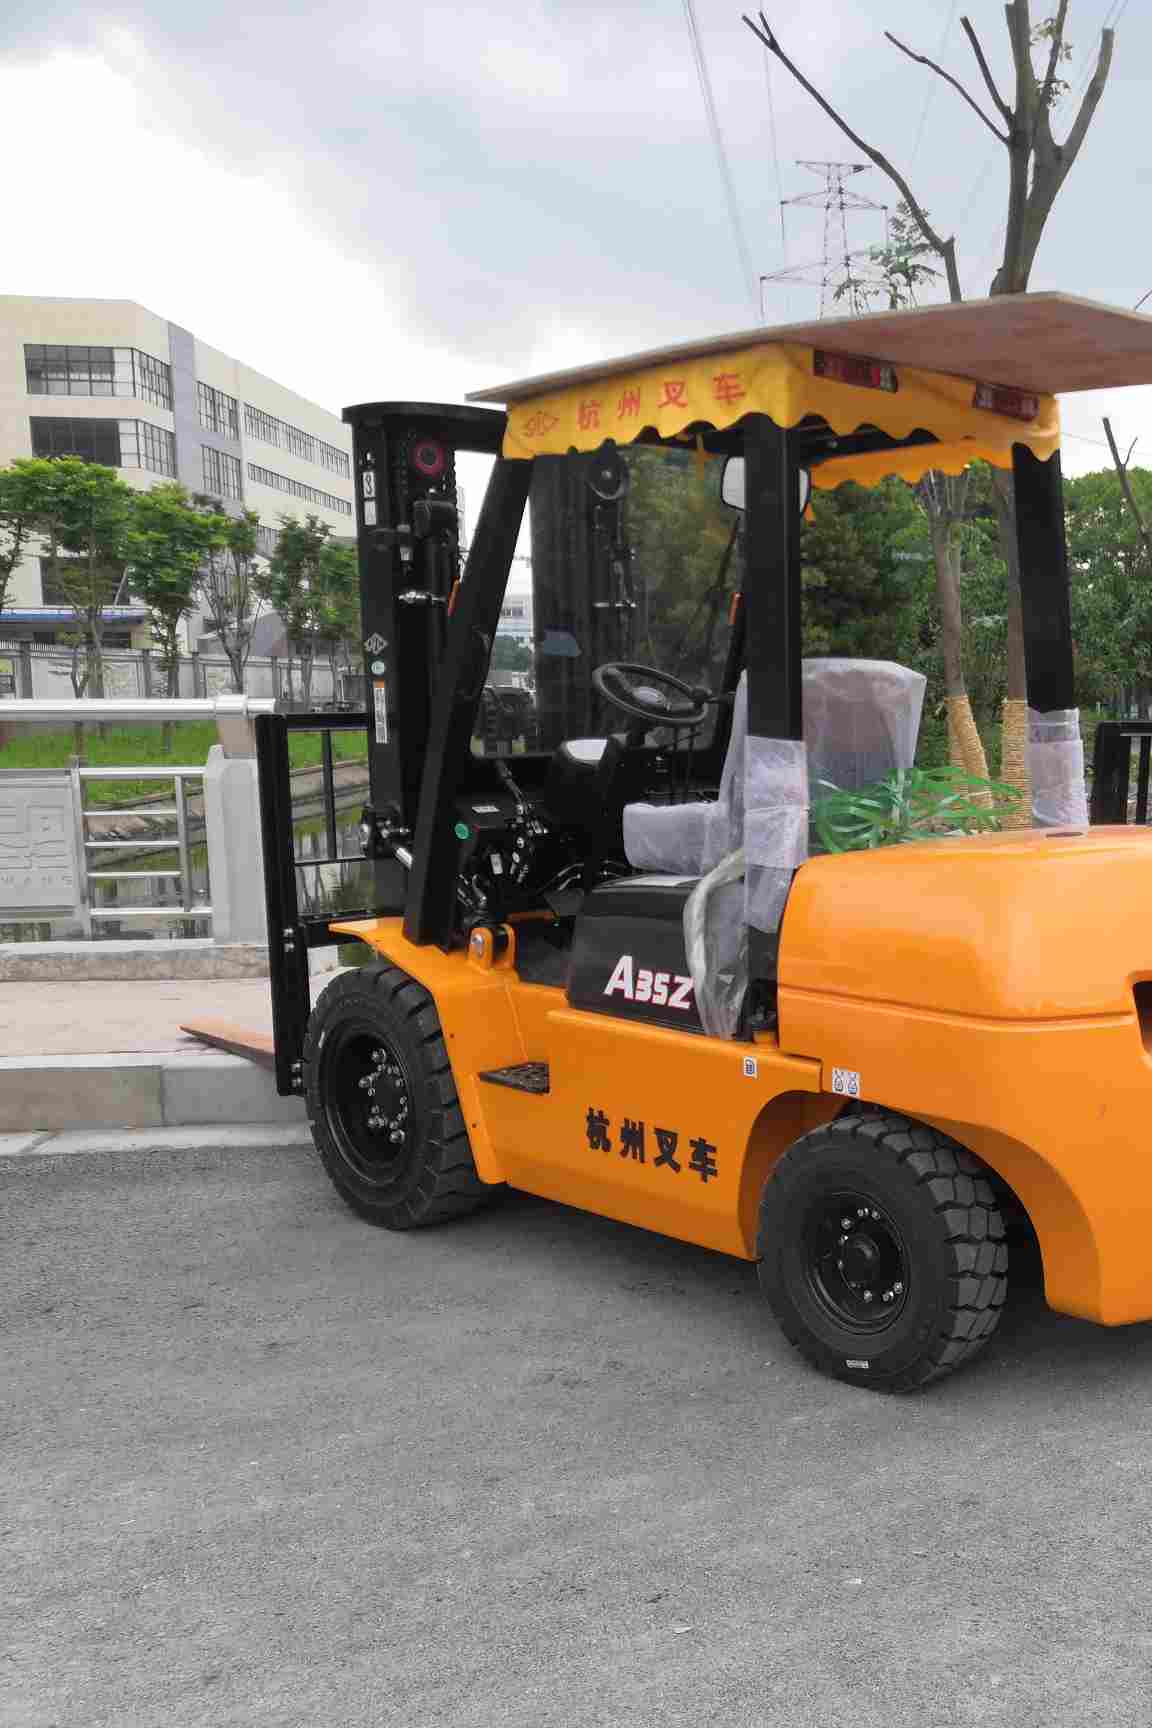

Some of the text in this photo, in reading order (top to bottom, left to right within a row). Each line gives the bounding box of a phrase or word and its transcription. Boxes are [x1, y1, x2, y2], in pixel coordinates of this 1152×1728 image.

[575, 373, 747, 431] 杭州叉车
[603, 955, 694, 1010] A35Z
[585, 1107, 719, 1184] 杭州叉车
